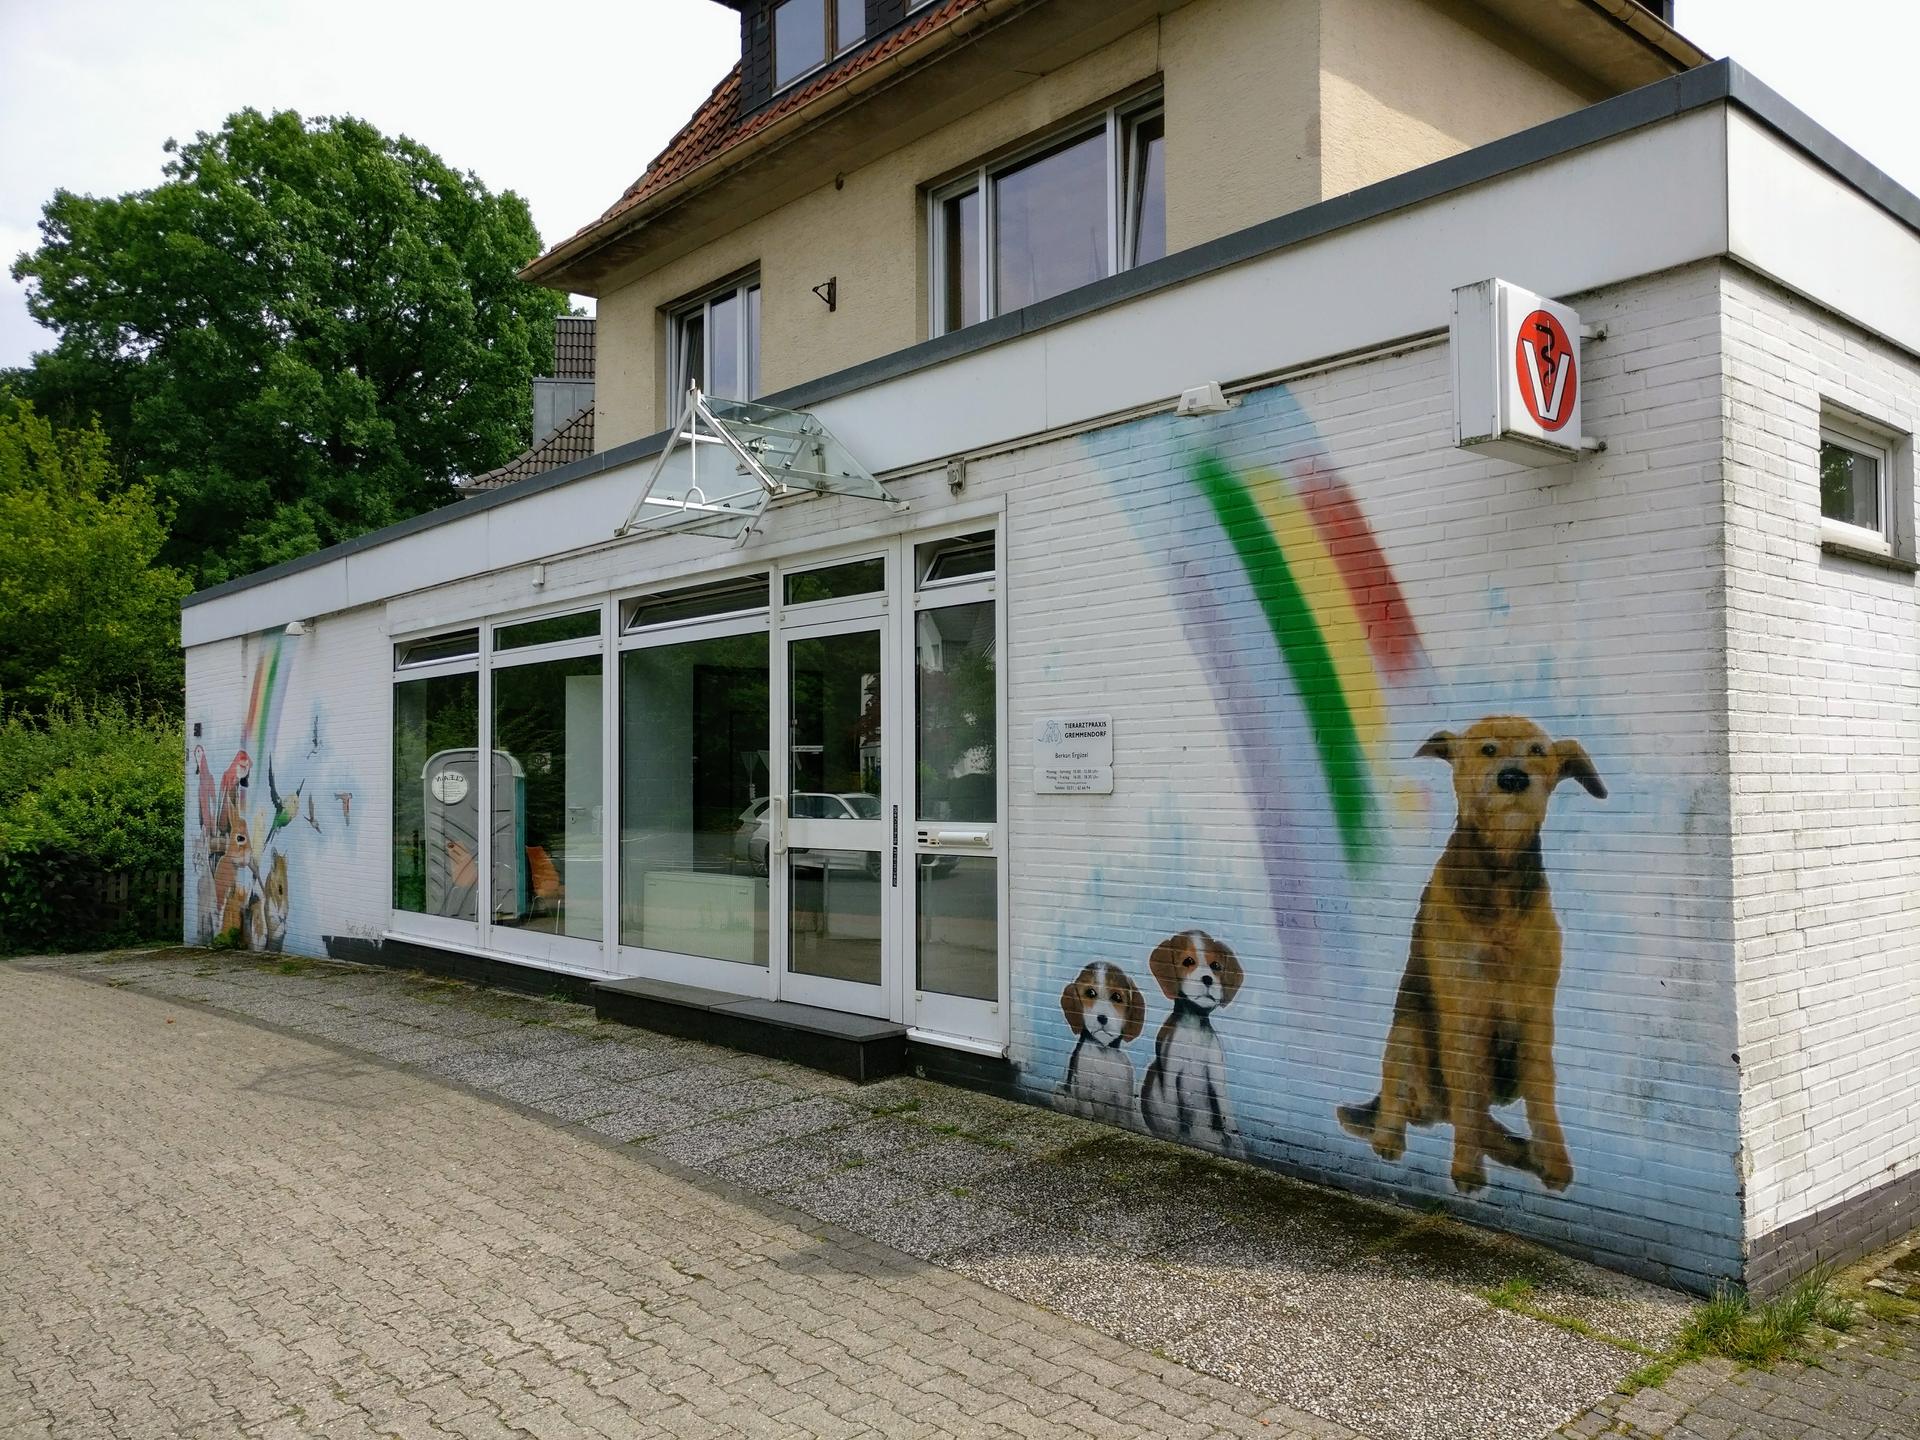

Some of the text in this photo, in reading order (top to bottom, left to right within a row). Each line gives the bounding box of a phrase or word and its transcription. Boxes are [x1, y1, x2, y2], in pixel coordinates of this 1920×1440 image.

[1521, 337, 1571, 423] V
[1064, 721, 1107, 729] TIERARZTPRAXIS
[1064, 731, 1107, 739] GREMMENDORF
